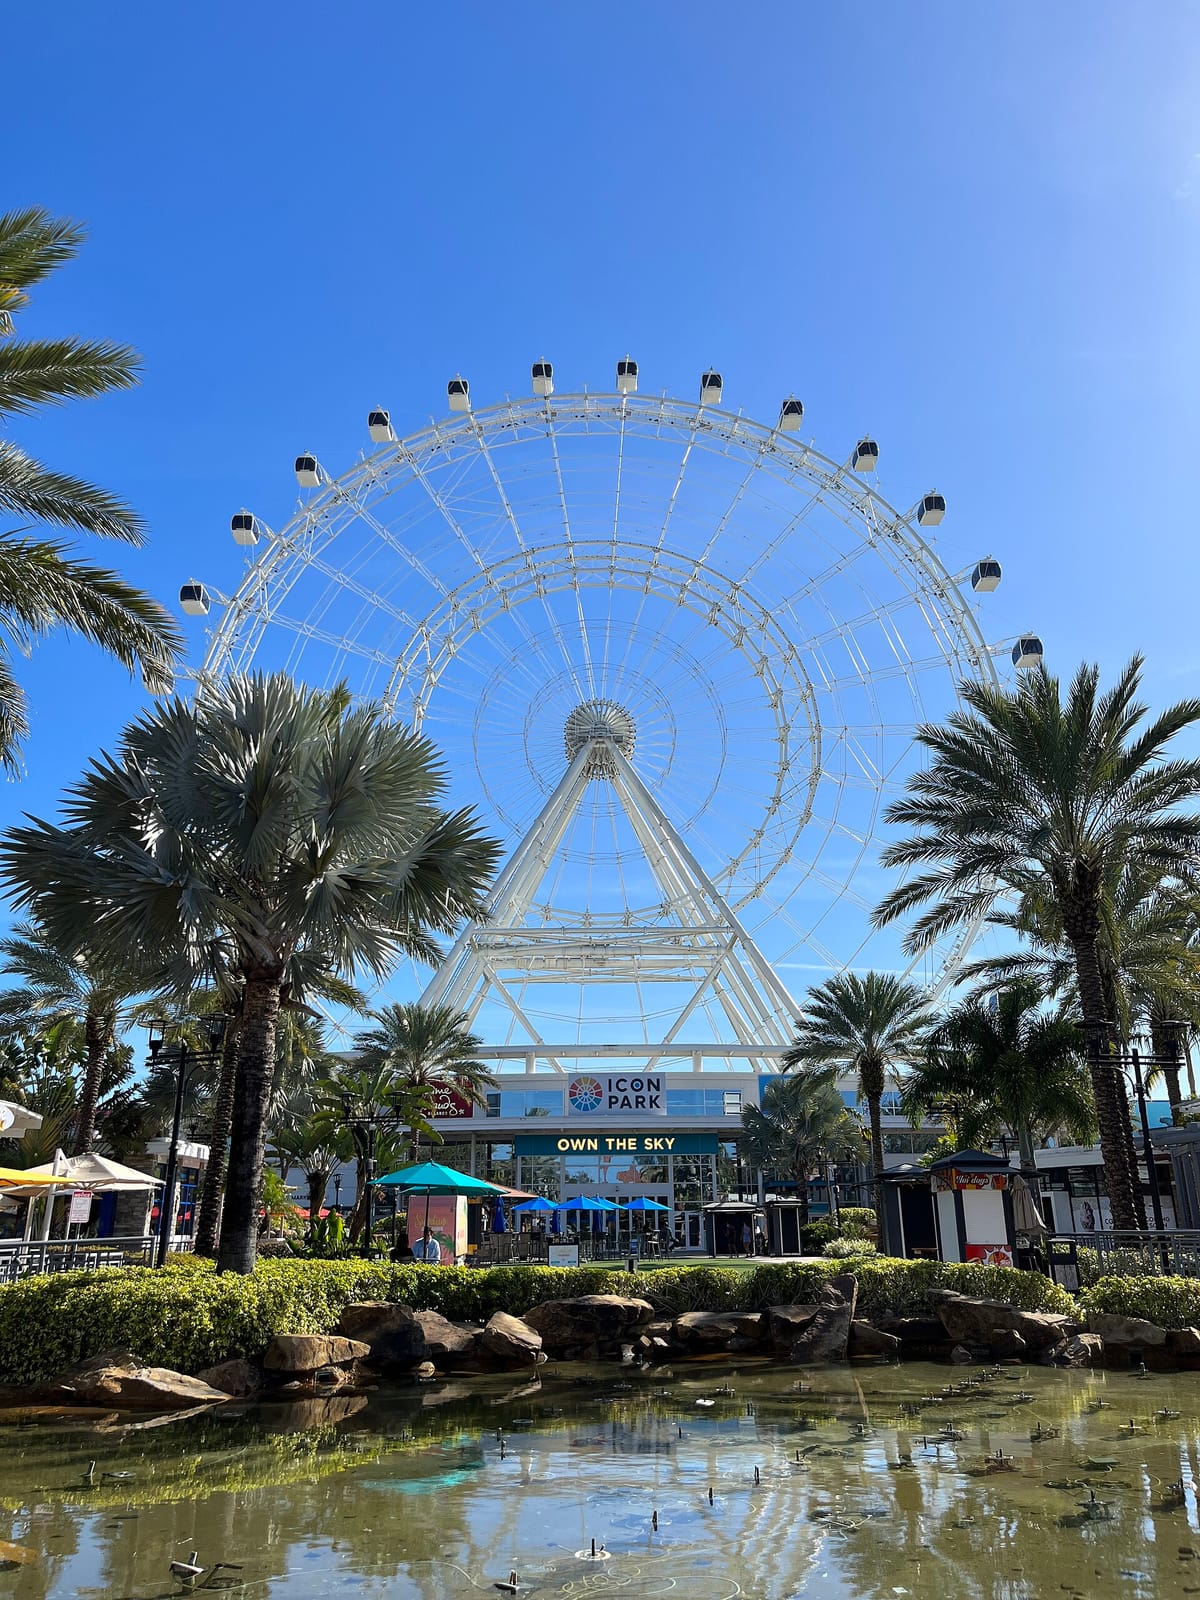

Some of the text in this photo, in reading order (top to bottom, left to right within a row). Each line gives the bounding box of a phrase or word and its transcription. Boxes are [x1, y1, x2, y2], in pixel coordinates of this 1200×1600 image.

[608, 1078, 660, 1092] ICON
[608, 1095, 661, 1109] PARK
[557, 1137, 675, 1151] OWN THE SKY
